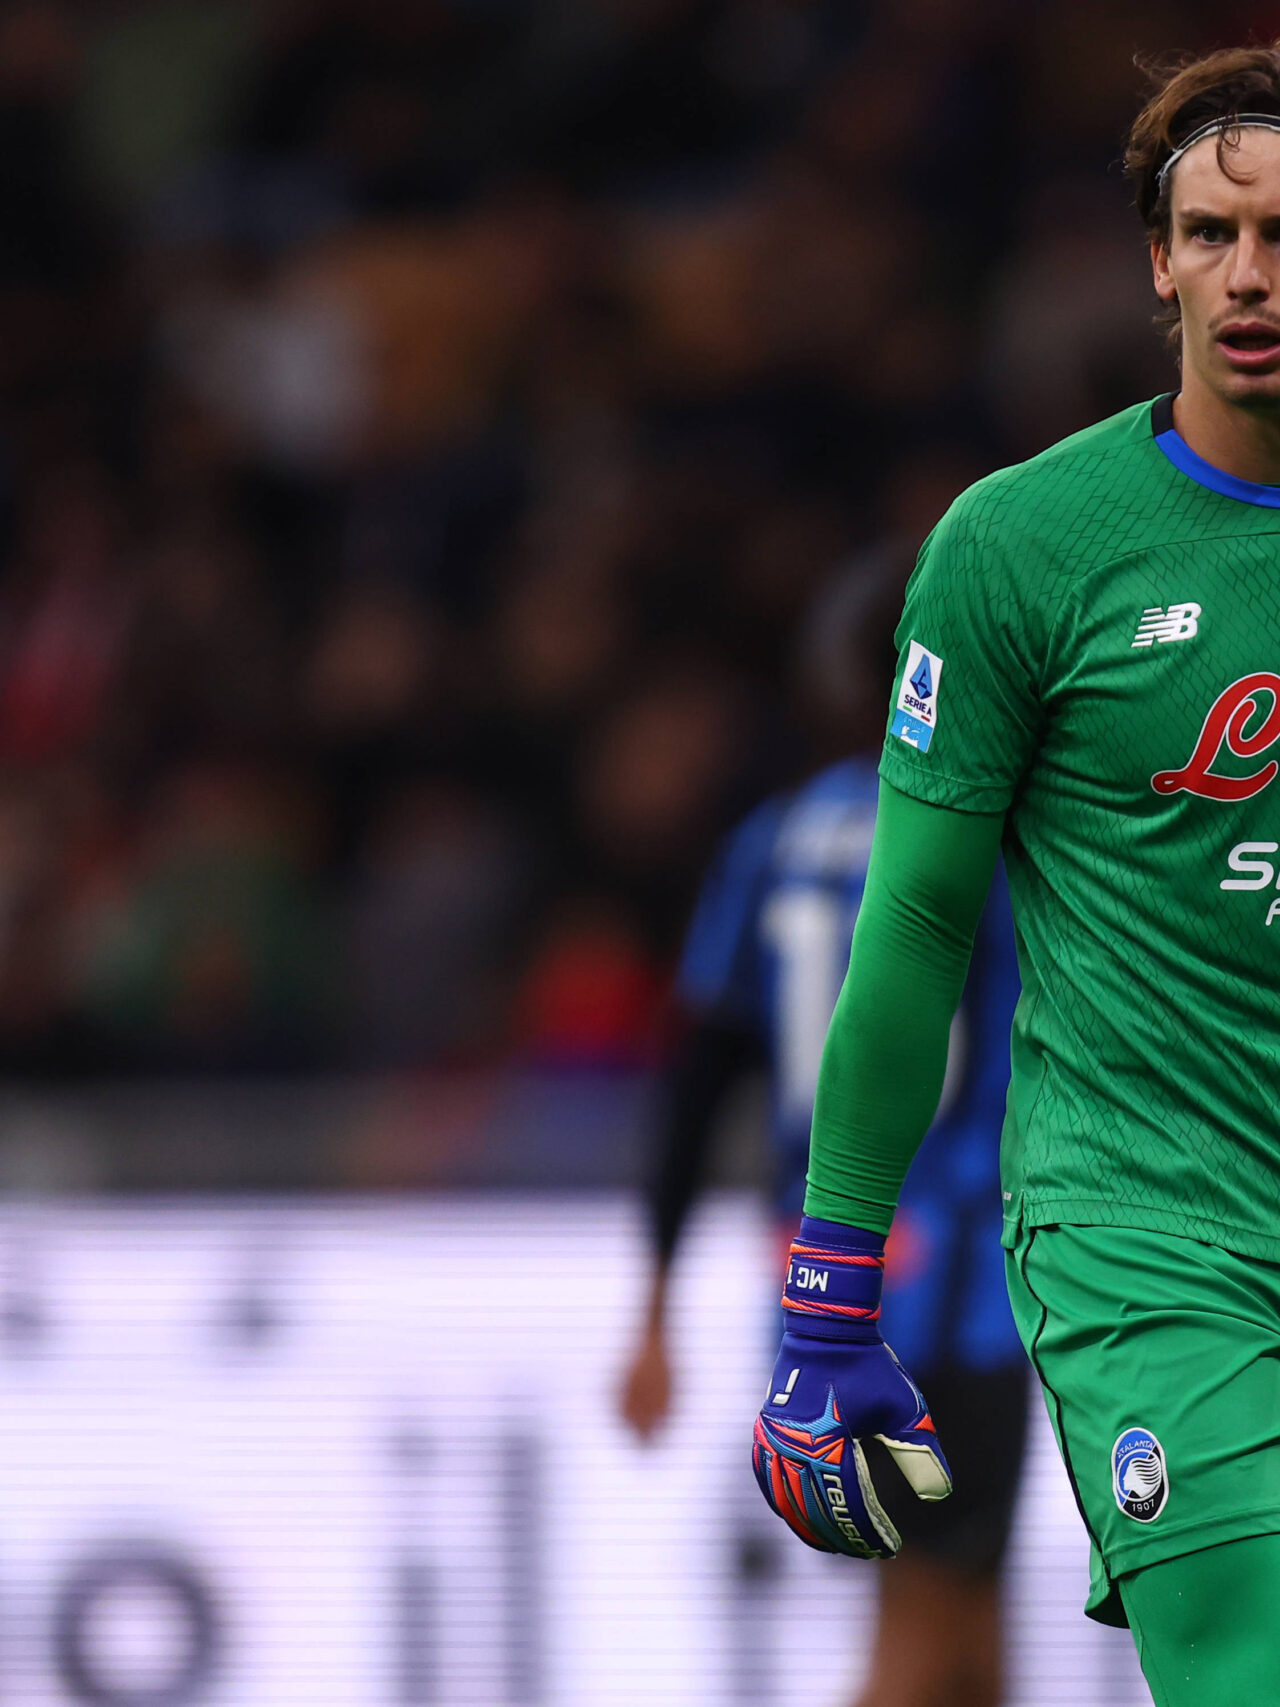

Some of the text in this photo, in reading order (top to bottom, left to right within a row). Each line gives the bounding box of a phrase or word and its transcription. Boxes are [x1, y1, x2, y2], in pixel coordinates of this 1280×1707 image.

[1131, 602, 1202, 648] NB
[904, 694, 932, 717] SERIE A
[796, 1266, 829, 1292] MC
[1117, 1441, 1154, 1458] ATALANTA
[1131, 1499, 1155, 1512] 1907
